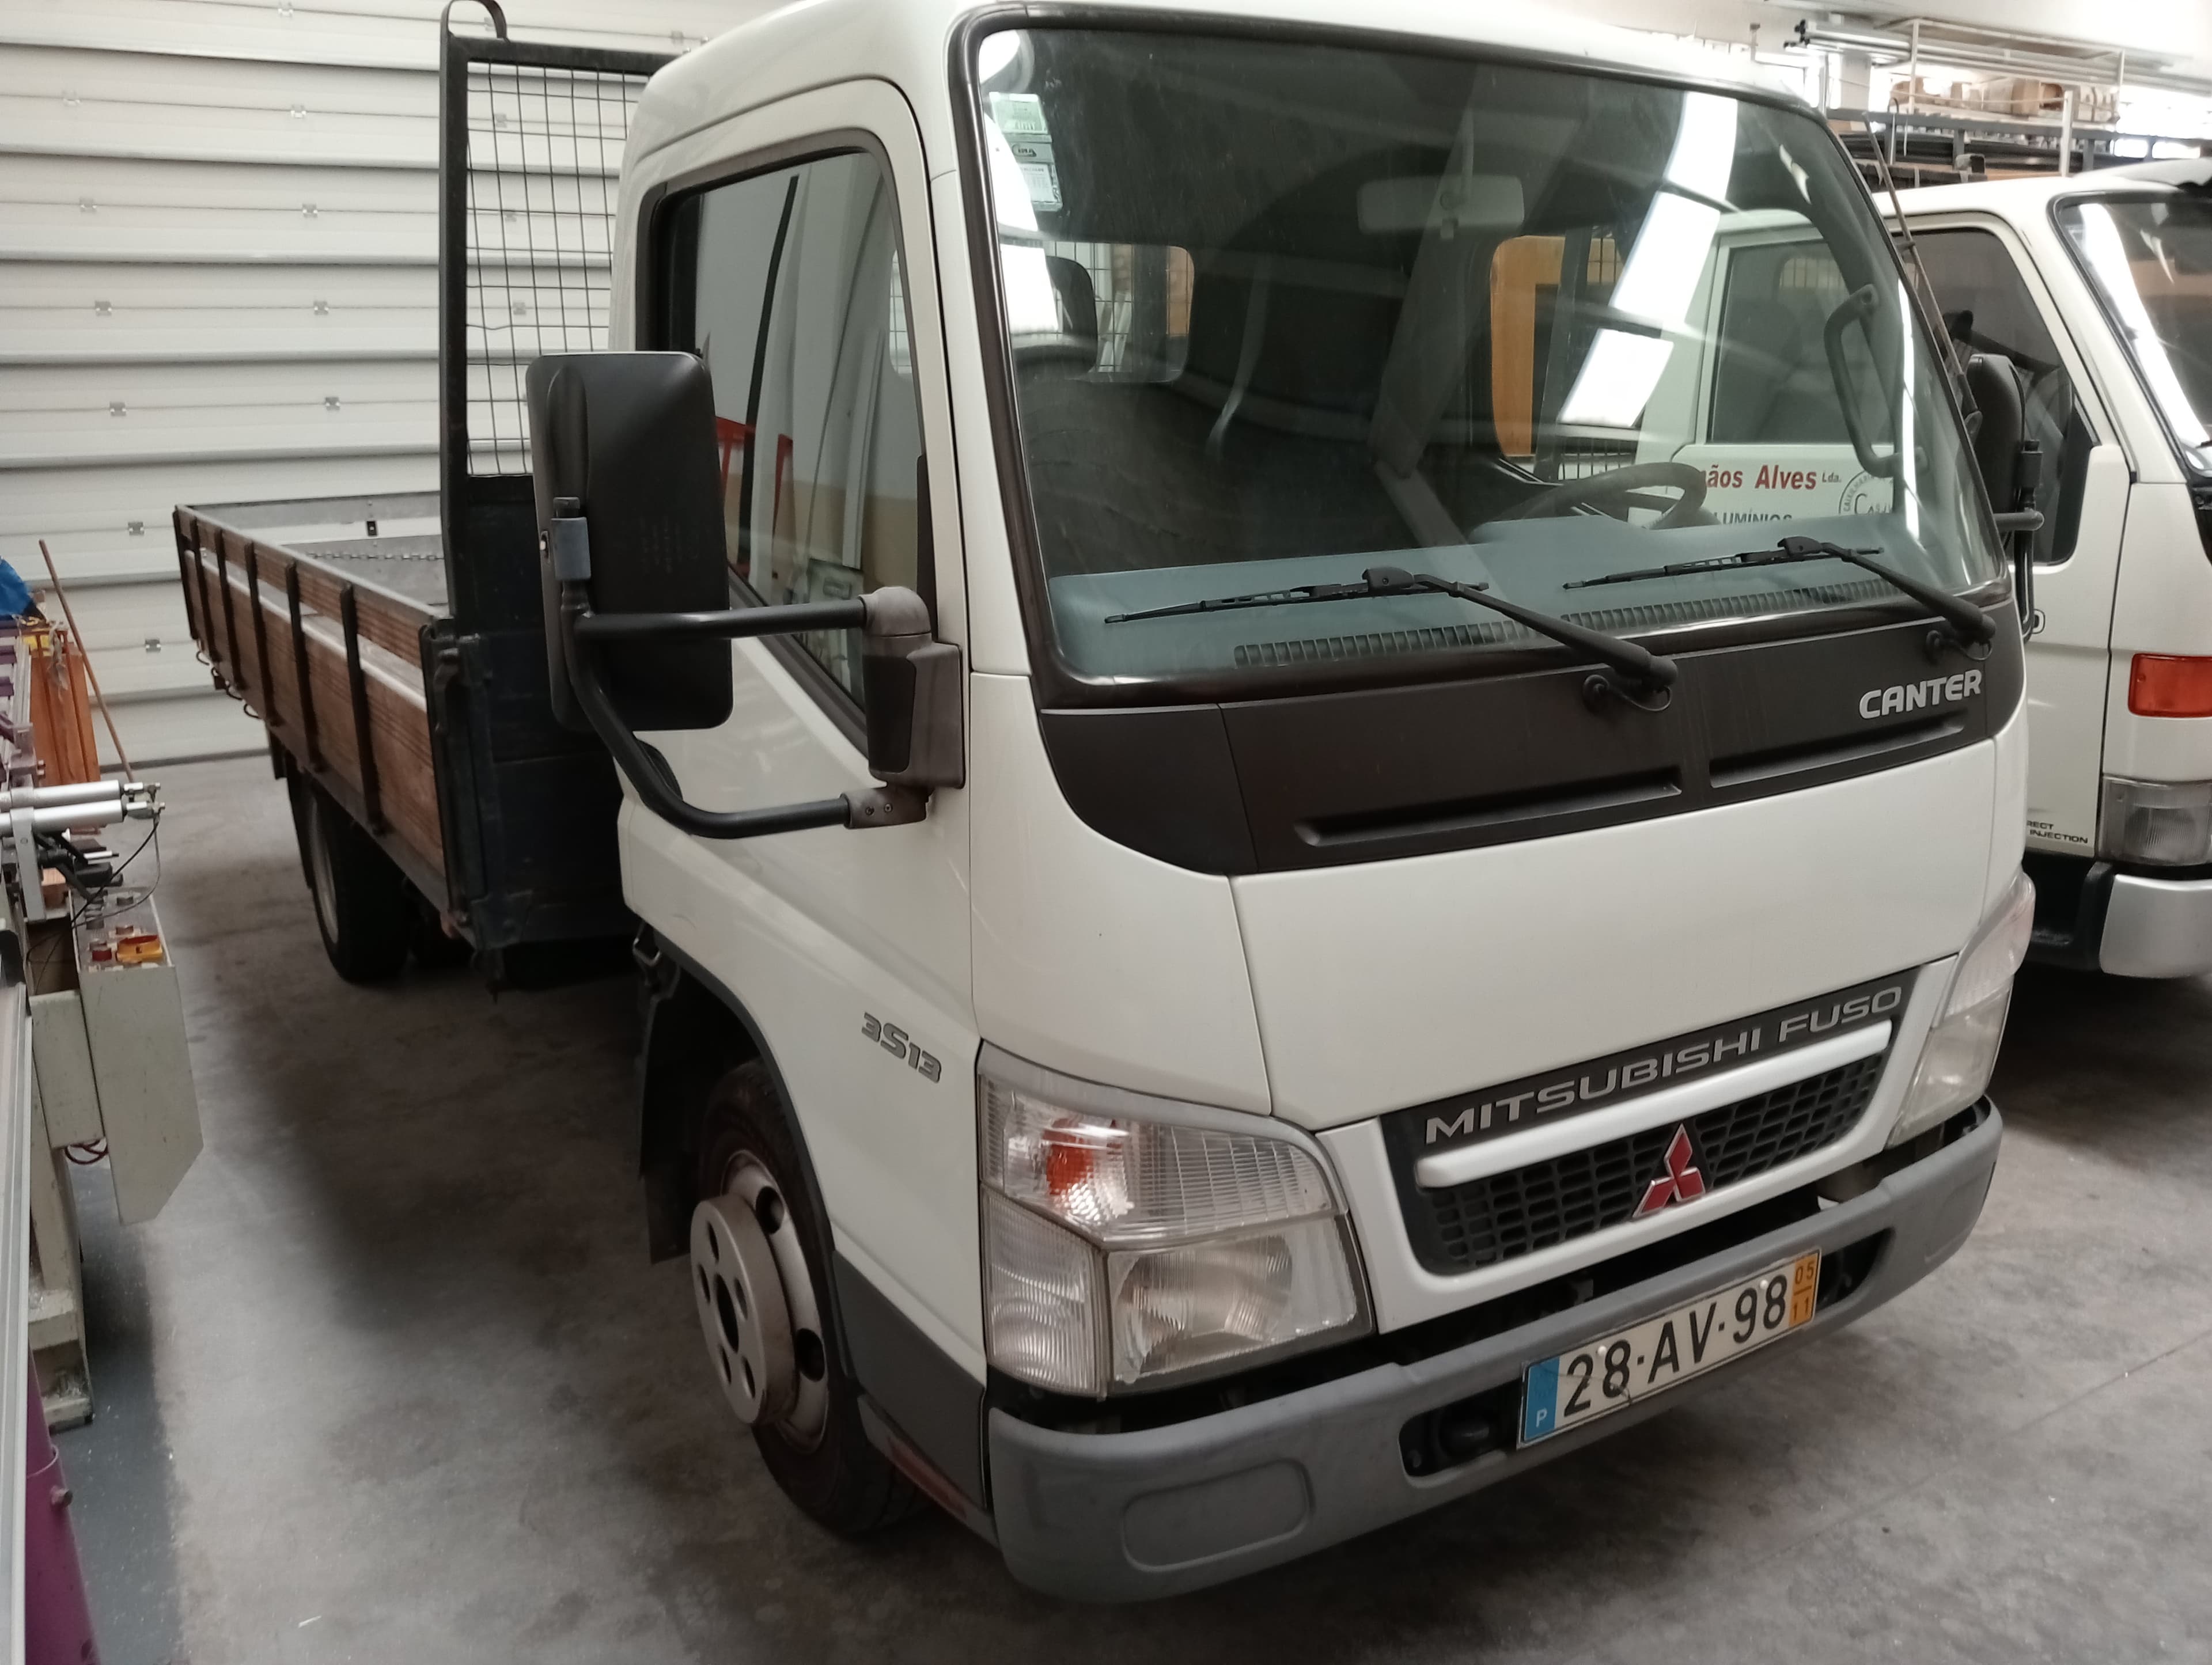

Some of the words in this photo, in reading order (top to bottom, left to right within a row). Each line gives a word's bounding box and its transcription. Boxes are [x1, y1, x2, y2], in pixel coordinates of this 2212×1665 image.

[1702, 464, 1743, 488] ãos
[1755, 464, 1817, 490] Alves
[1821, 472, 1842, 483] Lda.
[1859, 669, 1982, 719] CANTER
[2029, 829, 2088, 844] INJECTION
[862, 1012, 942, 1083] 3S13
[1425, 1028, 1760, 1144] MITSUBISHI
[1779, 987, 1902, 1042] FUSO
[1795, 1260, 1815, 1285] 05
[1793, 1297, 1809, 1321] 11
[1536, 1408, 1547, 1428] P
